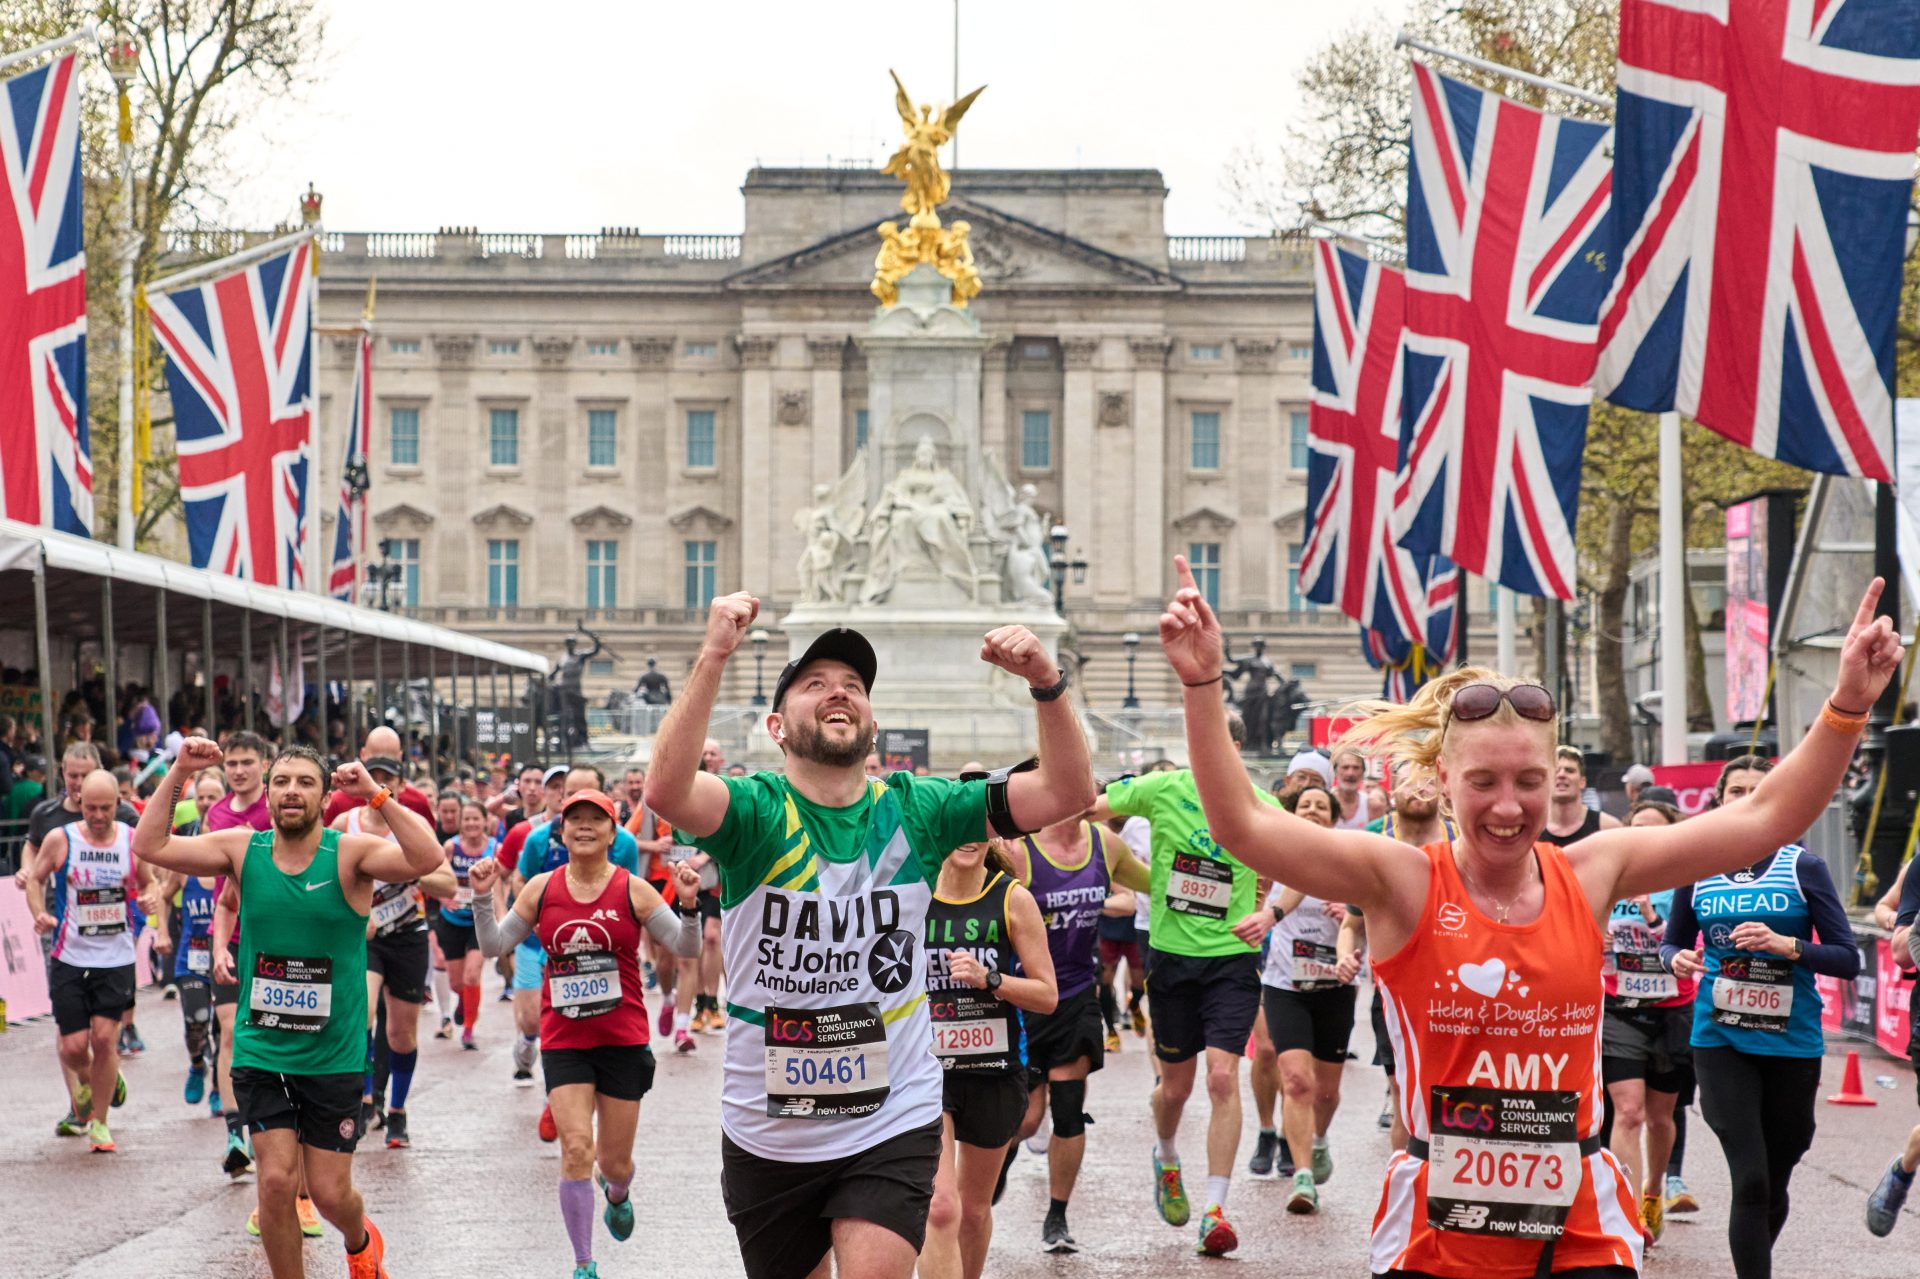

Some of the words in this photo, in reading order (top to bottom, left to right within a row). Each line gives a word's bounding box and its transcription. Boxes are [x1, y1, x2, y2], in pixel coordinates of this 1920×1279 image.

[80, 851, 120, 864] DAMON
[1175, 854, 1199, 873] tcs
[1046, 886, 1106, 908] HECTOR
[1181, 879, 1217, 899] 8937
[1701, 893, 1789, 917] SINEAD
[761, 889, 900, 943] DAVID
[1050, 909, 1078, 930] LY
[1433, 928, 1469, 939] SCIMITAR
[286, 960, 304, 968] TATA
[757, 938, 785, 970] St
[789, 944, 860, 974] John
[1750, 960, 1768, 968] TATA
[258, 956, 285, 977] tcs
[286, 967, 328, 975] CONSULTANCY
[553, 959, 577, 975] tcs
[1721, 959, 1748, 978] tcs
[754, 969, 860, 995] Ambulance
[1749, 973, 1776, 981] SERVICES
[562, 977, 609, 999] 39209
[1625, 978, 1667, 993] 64811
[262, 986, 318, 1010] 39546
[957, 997, 976, 1005] TATA
[1726, 986, 1781, 1010] 11506
[957, 1003, 1000, 1011] CONSULTANCY
[957, 1009, 985, 1017] SERVICES
[816, 1013, 842, 1025] TATA
[1427, 1000, 1474, 1021] Helen
[1478, 1000, 1490, 1020] &
[1493, 1000, 1559, 1034] Douglas
[1562, 1002, 1597, 1021] House
[1740, 1021, 1754, 1029] new
[293, 1021, 321, 1032] balance
[773, 1013, 814, 1042] tcs
[817, 1018, 877, 1034] CONSULTANCY
[1429, 1021, 1481, 1036] hospice
[1485, 1025, 1519, 1037] care
[1537, 1023, 1557, 1038] for
[817, 1031, 857, 1043] SERVICES
[937, 1026, 994, 1050] 12980
[785, 1053, 867, 1086] 50461
[1466, 1050, 1570, 1091] AMY
[817, 1107, 838, 1116] new
[839, 1101, 881, 1115] balance
[1441, 1093, 1495, 1132] tcs
[1501, 1098, 1537, 1111] TATA
[1500, 1111, 1576, 1124] CONSULTANCY
[1500, 1122, 1552, 1136] SERVICES
[1452, 1147, 1564, 1191] 20673
[1489, 1220, 1517, 1232] new
